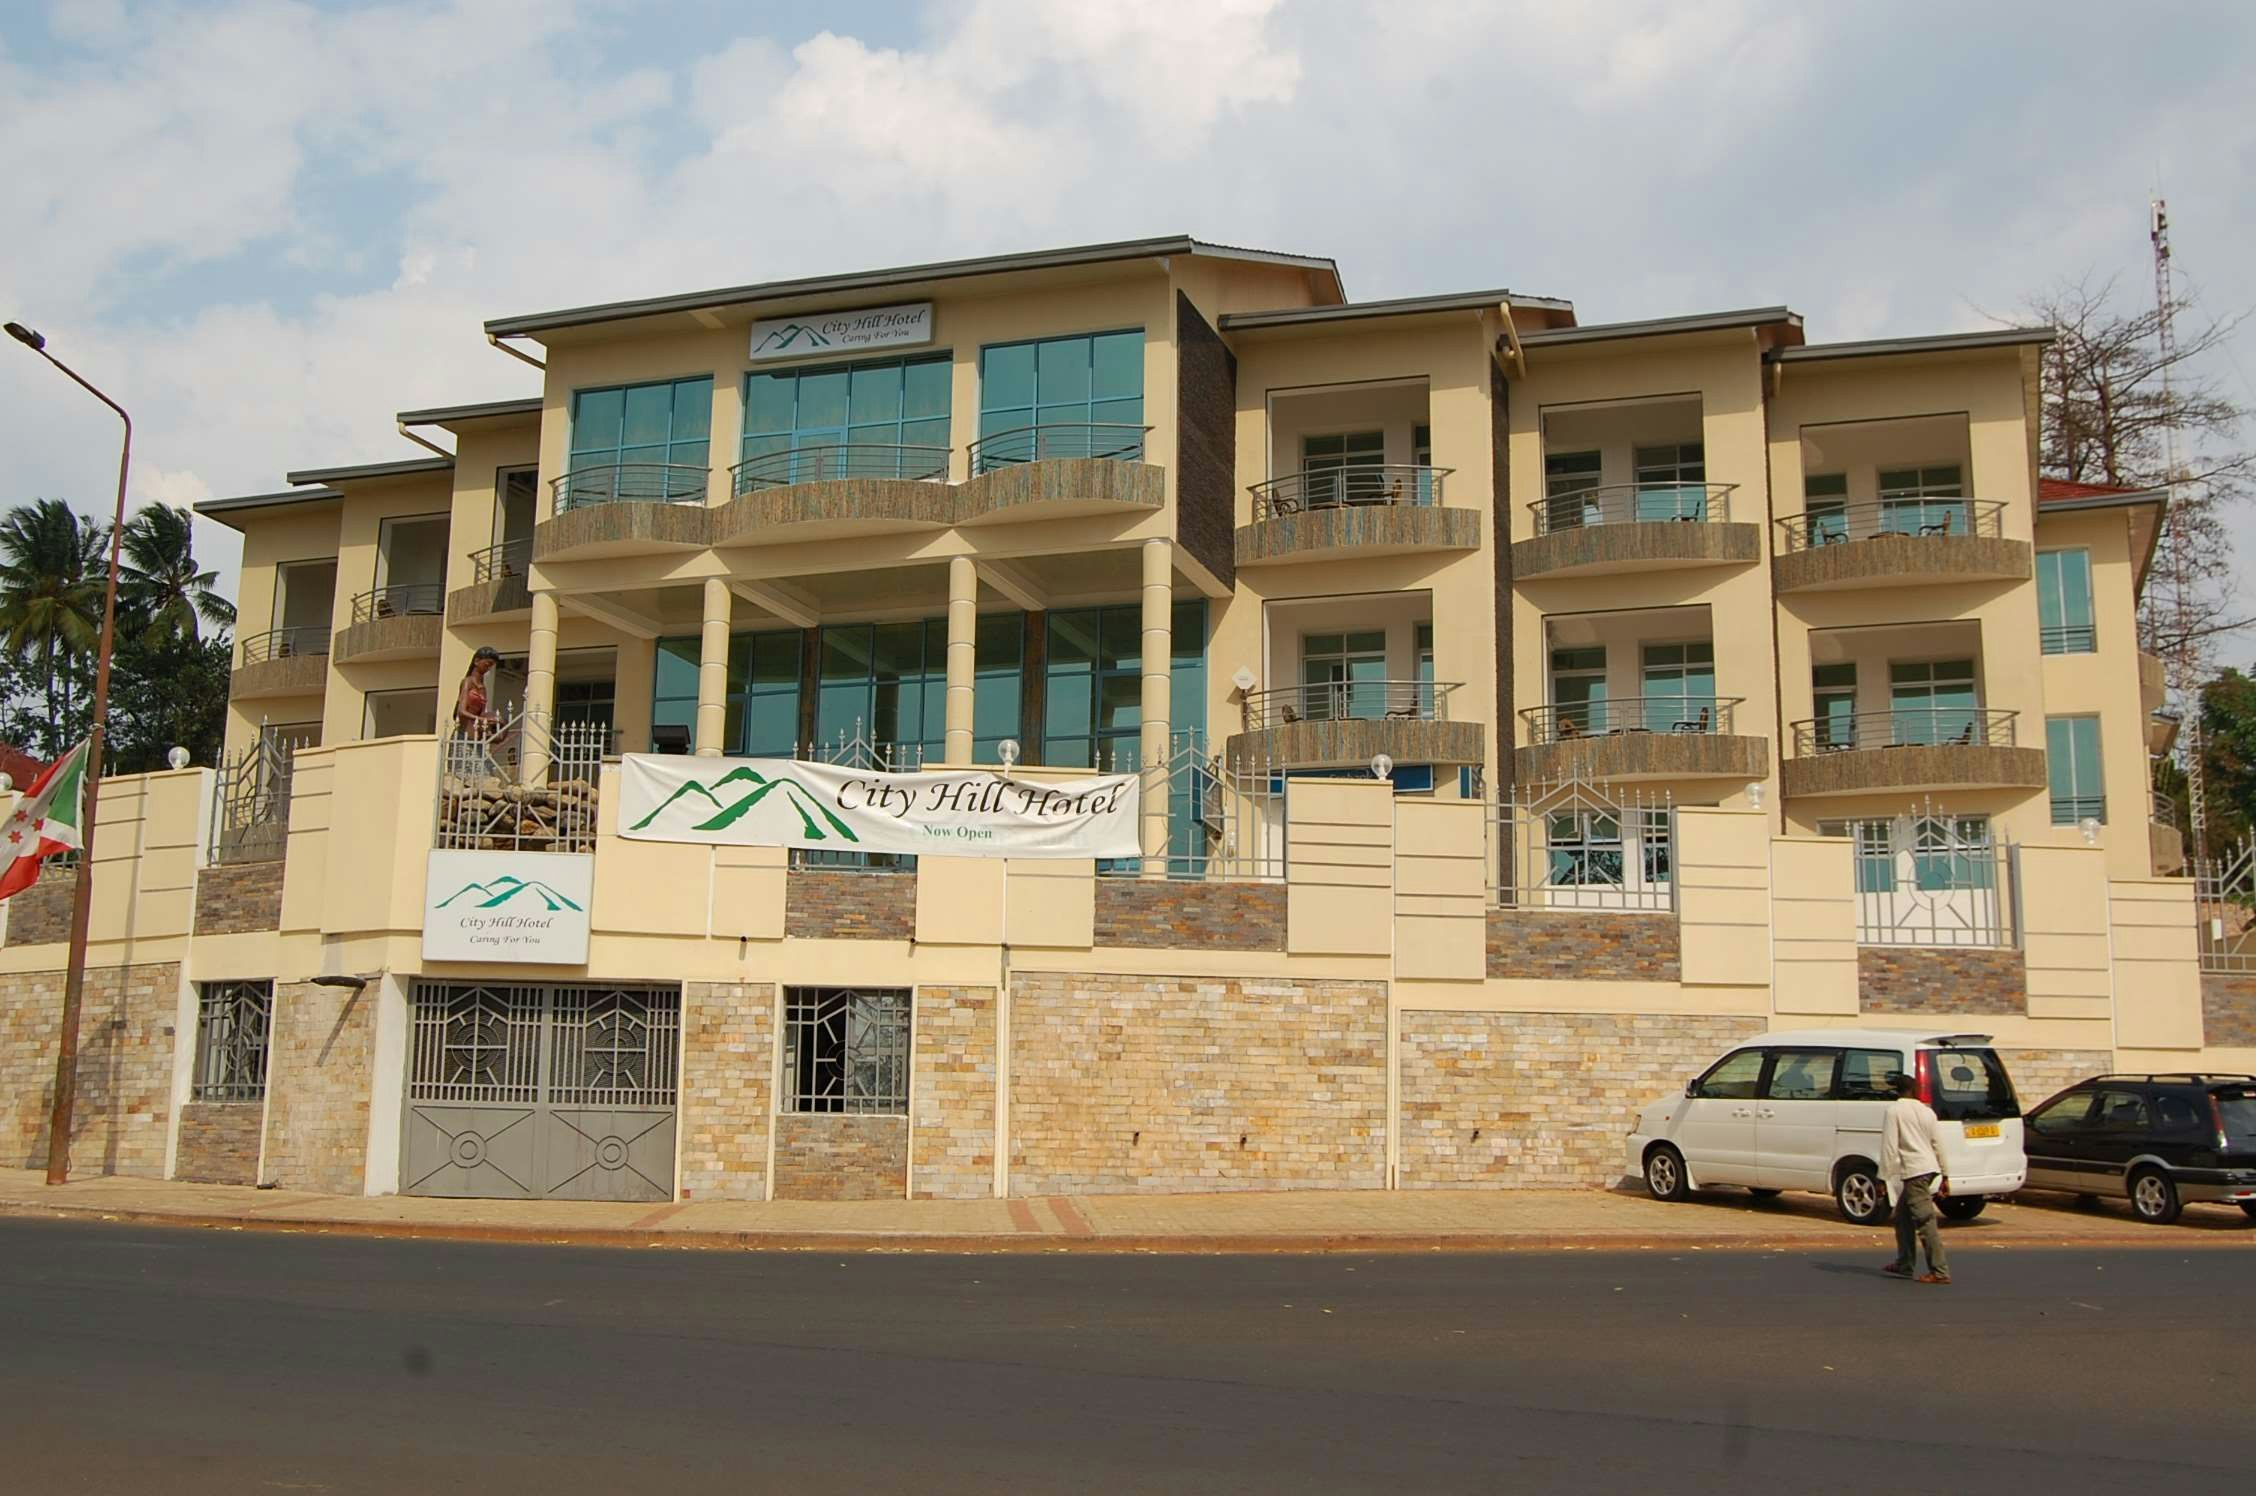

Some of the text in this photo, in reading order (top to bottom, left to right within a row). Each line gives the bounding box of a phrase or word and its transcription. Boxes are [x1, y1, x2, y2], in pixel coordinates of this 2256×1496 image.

[822, 309, 925, 335] City Hill Hotel
[836, 779, 1126, 818] City Hill Hotel
[923, 824, 992, 841] Now Open
[460, 916, 554, 930] City Hill Hotel
[470, 935, 541, 945] Caring For You
